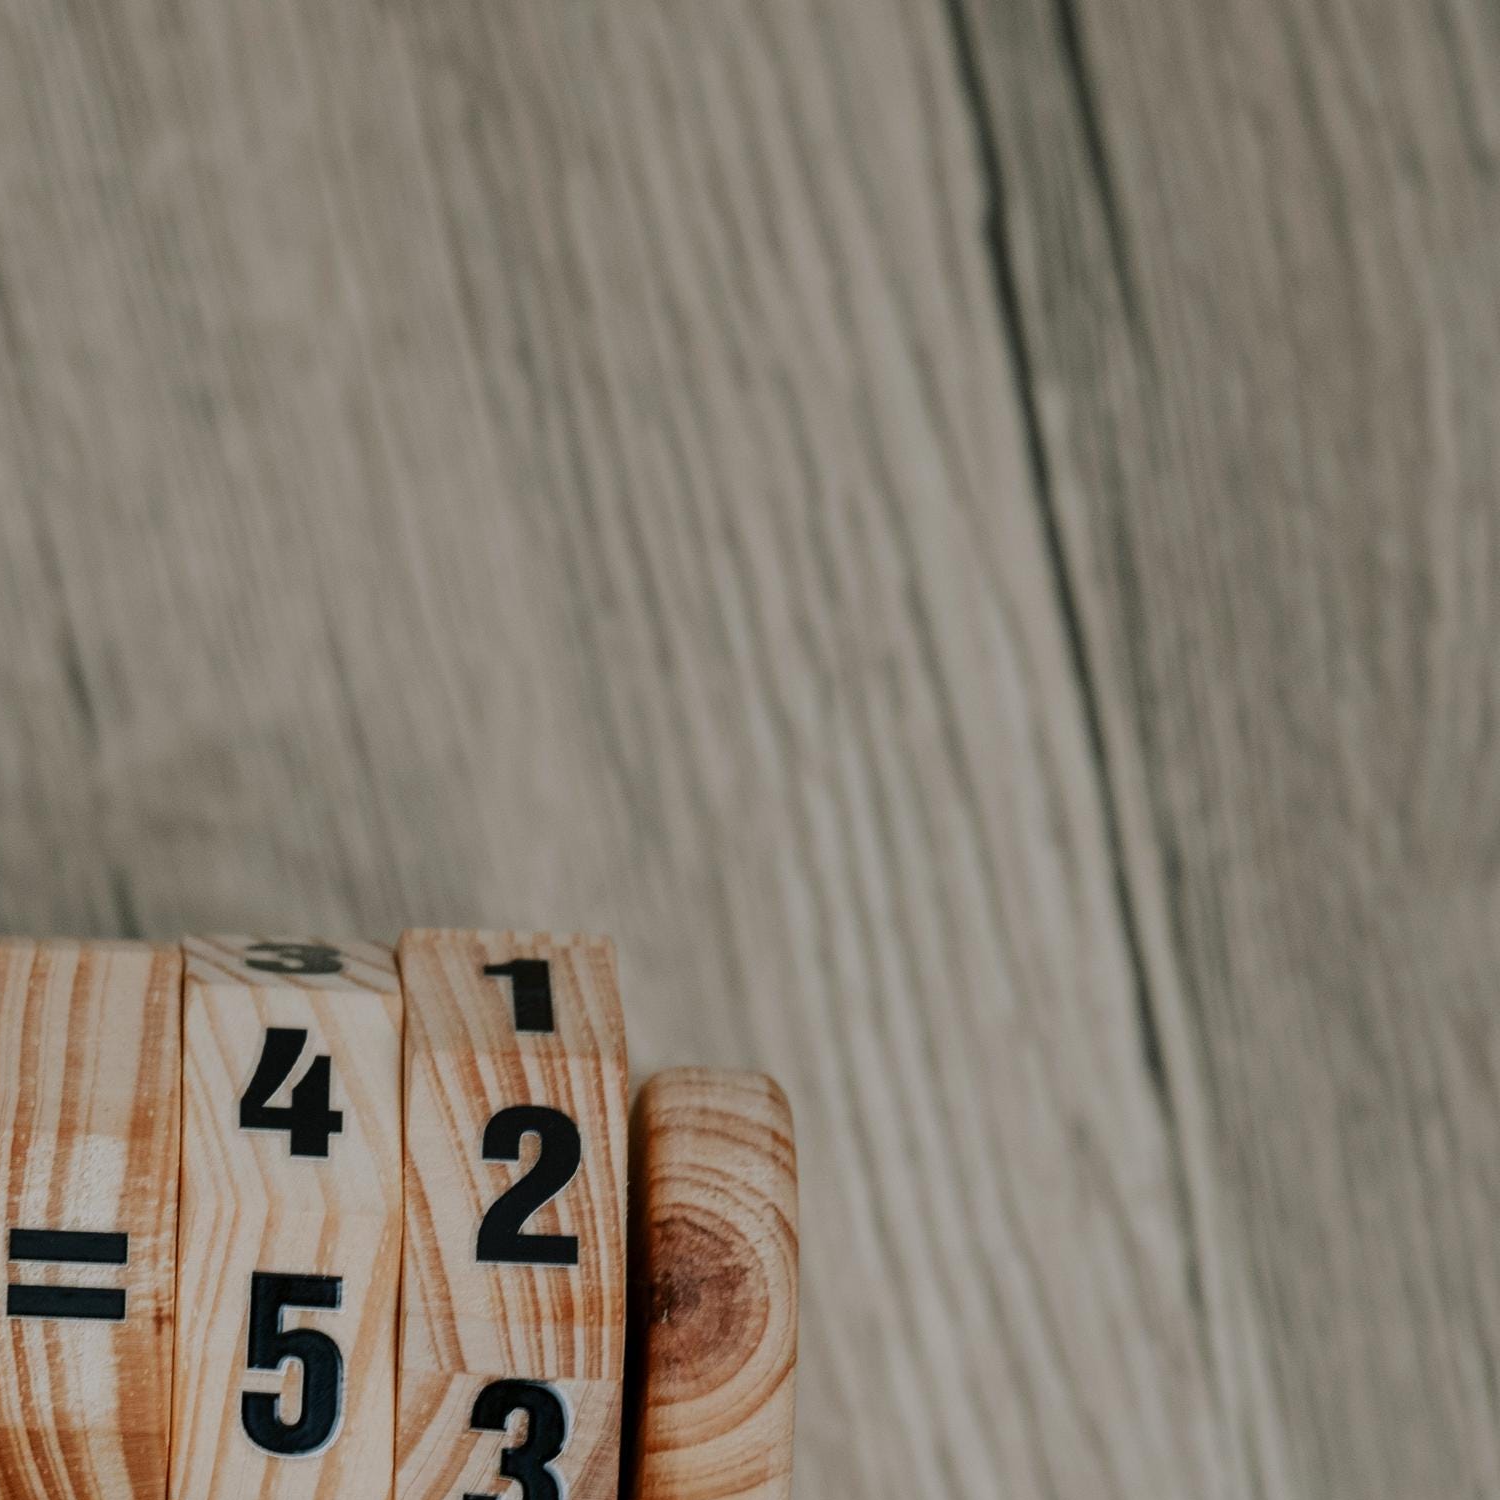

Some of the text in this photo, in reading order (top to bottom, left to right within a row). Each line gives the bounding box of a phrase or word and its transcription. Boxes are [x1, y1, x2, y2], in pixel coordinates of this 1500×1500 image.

[483, 958, 555, 1033] 1
[240, 1028, 343, 1158] 4
[476, 1105, 581, 1265] 2
[6, 1228, 128, 1320] =
[241, 1271, 344, 1457] 5
